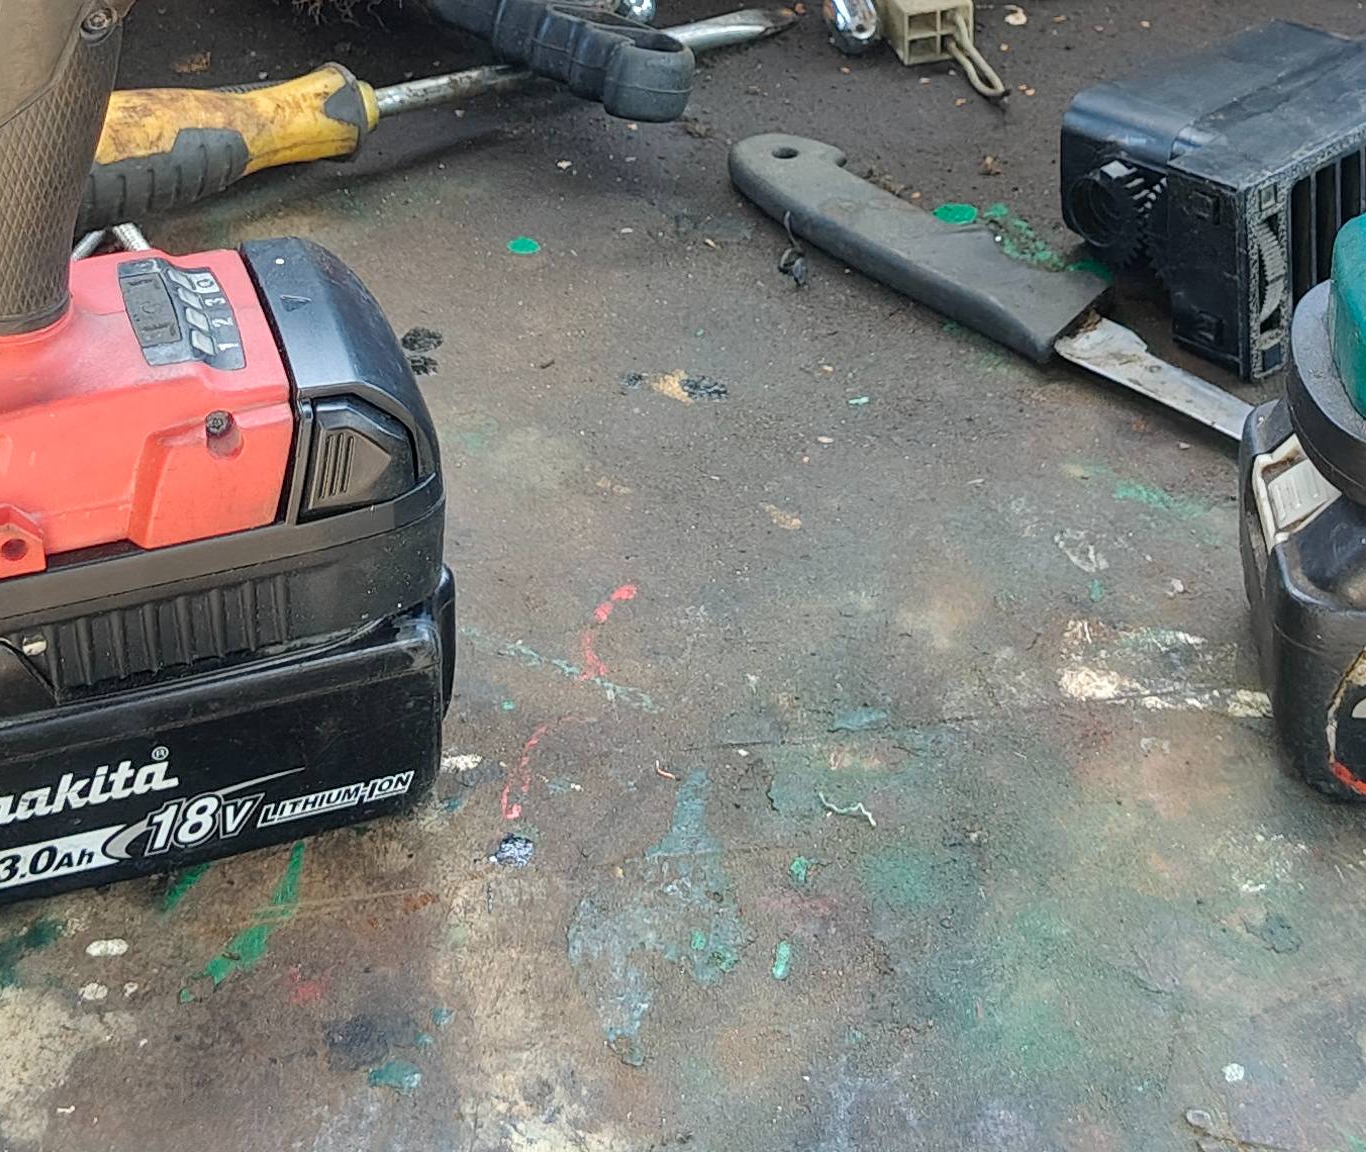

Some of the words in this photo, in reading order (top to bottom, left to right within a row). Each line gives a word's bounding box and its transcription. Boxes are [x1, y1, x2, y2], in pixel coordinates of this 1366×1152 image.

[204, 297, 226, 307] 3
[211, 317, 234, 328] 2
[218, 342, 240, 351] 1
[146, 794, 261, 854] 18V
[259, 774, 412, 825] LITHIUM-ION
